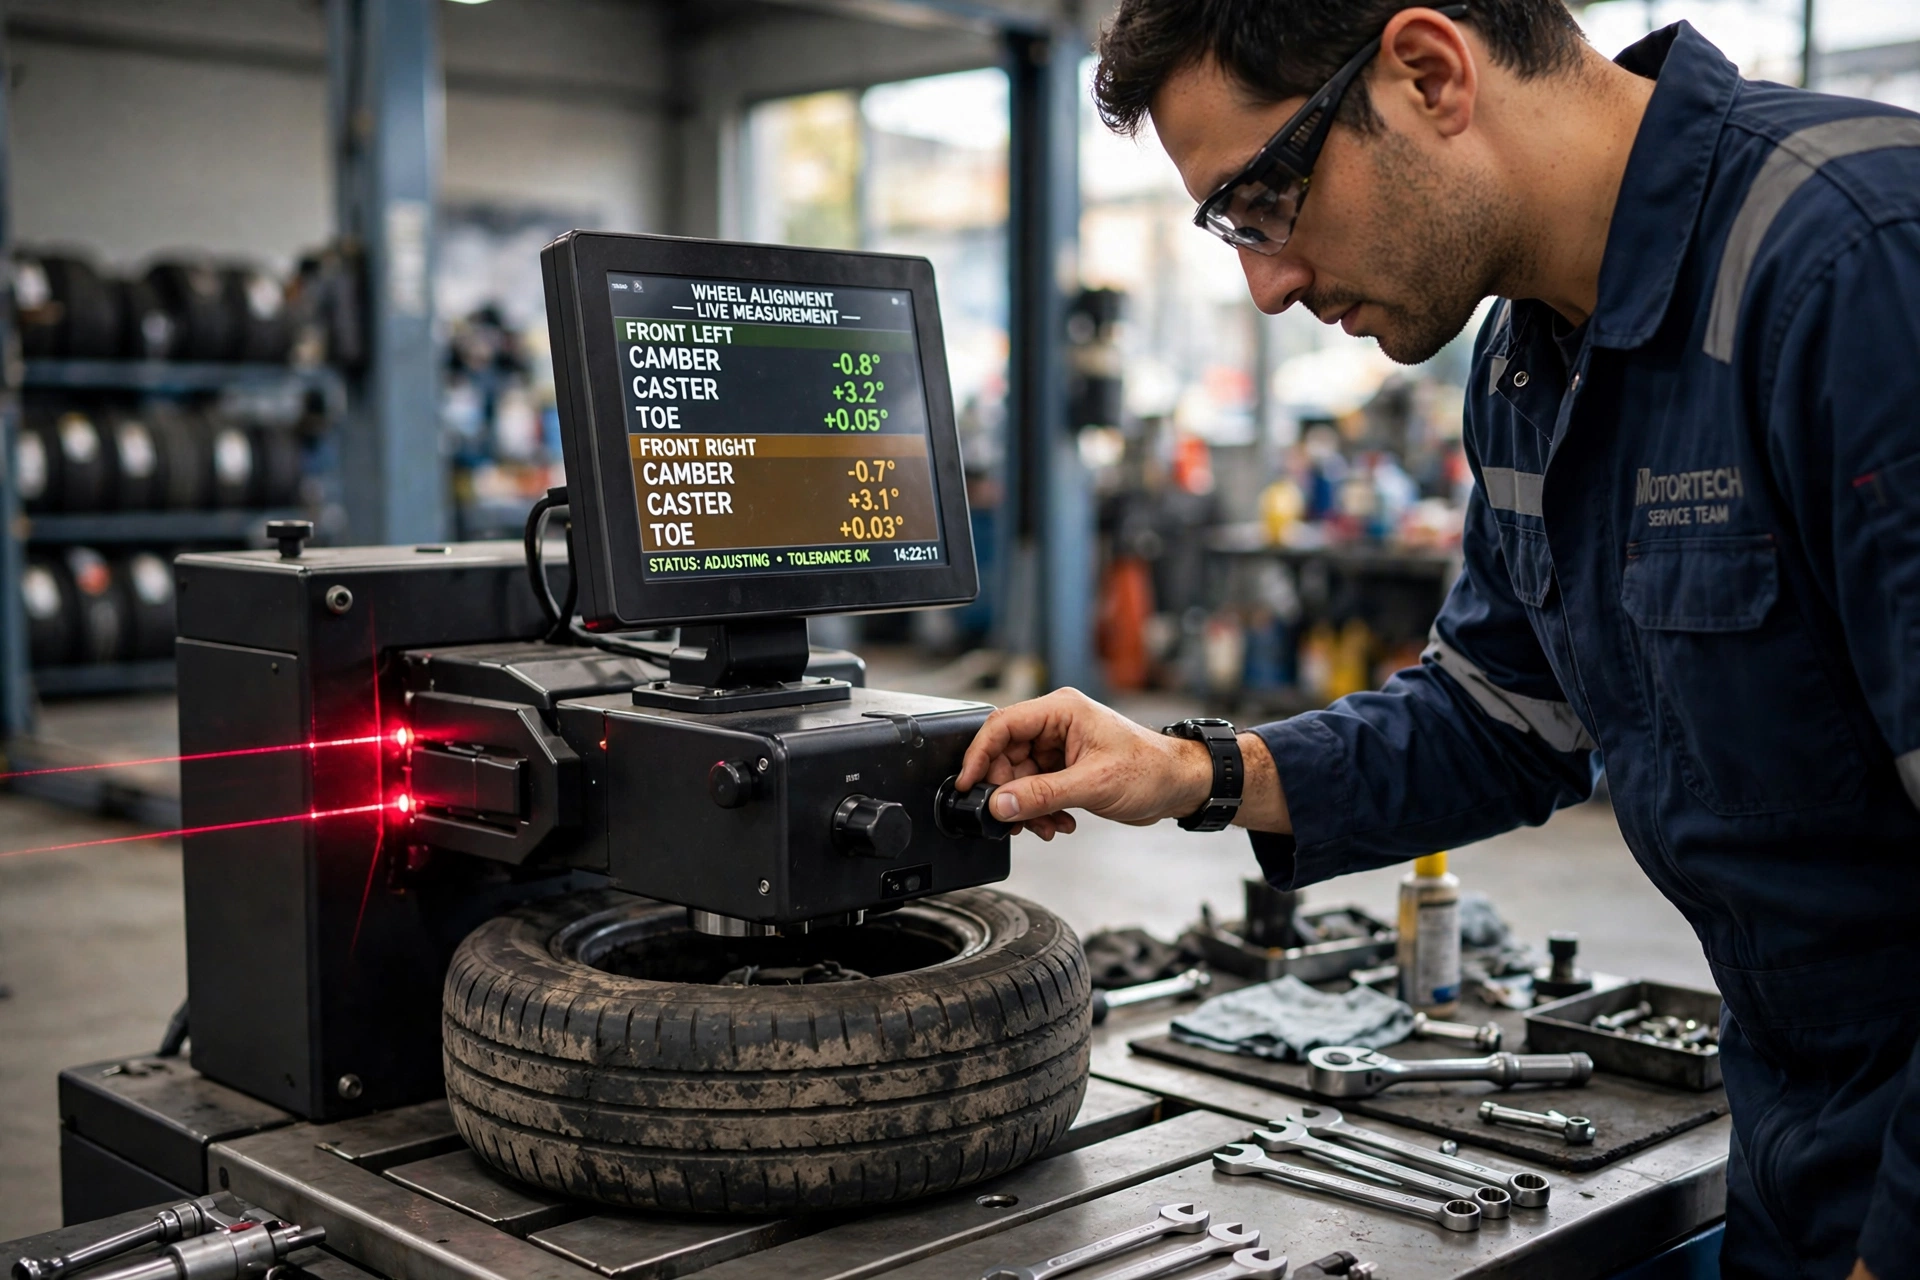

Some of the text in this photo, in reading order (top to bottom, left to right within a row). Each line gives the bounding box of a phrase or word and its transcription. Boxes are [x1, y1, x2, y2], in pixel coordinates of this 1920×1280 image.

[691, 283, 834, 308] WHEEL ALIGNMENT
[697, 302, 839, 325] LIVE MEASUREMENT
[626, 321, 733, 344] FRONT LEFT
[629, 346, 721, 371] CAMBER
[633, 376, 719, 400] CASTER
[636, 406, 681, 429] TOE
[640, 438, 756, 457] FRONT RIGHT
[643, 462, 735, 486] CAMBER
[647, 491, 733, 516] CASTER
[1648, 504, 1729, 526] SERVICE TEAM
[650, 522, 695, 546] TOE
[649, 548, 871, 573] STATUS: ADJUSTING TOLERANCE OK
[893, 546, 939, 561] 14:22:11
